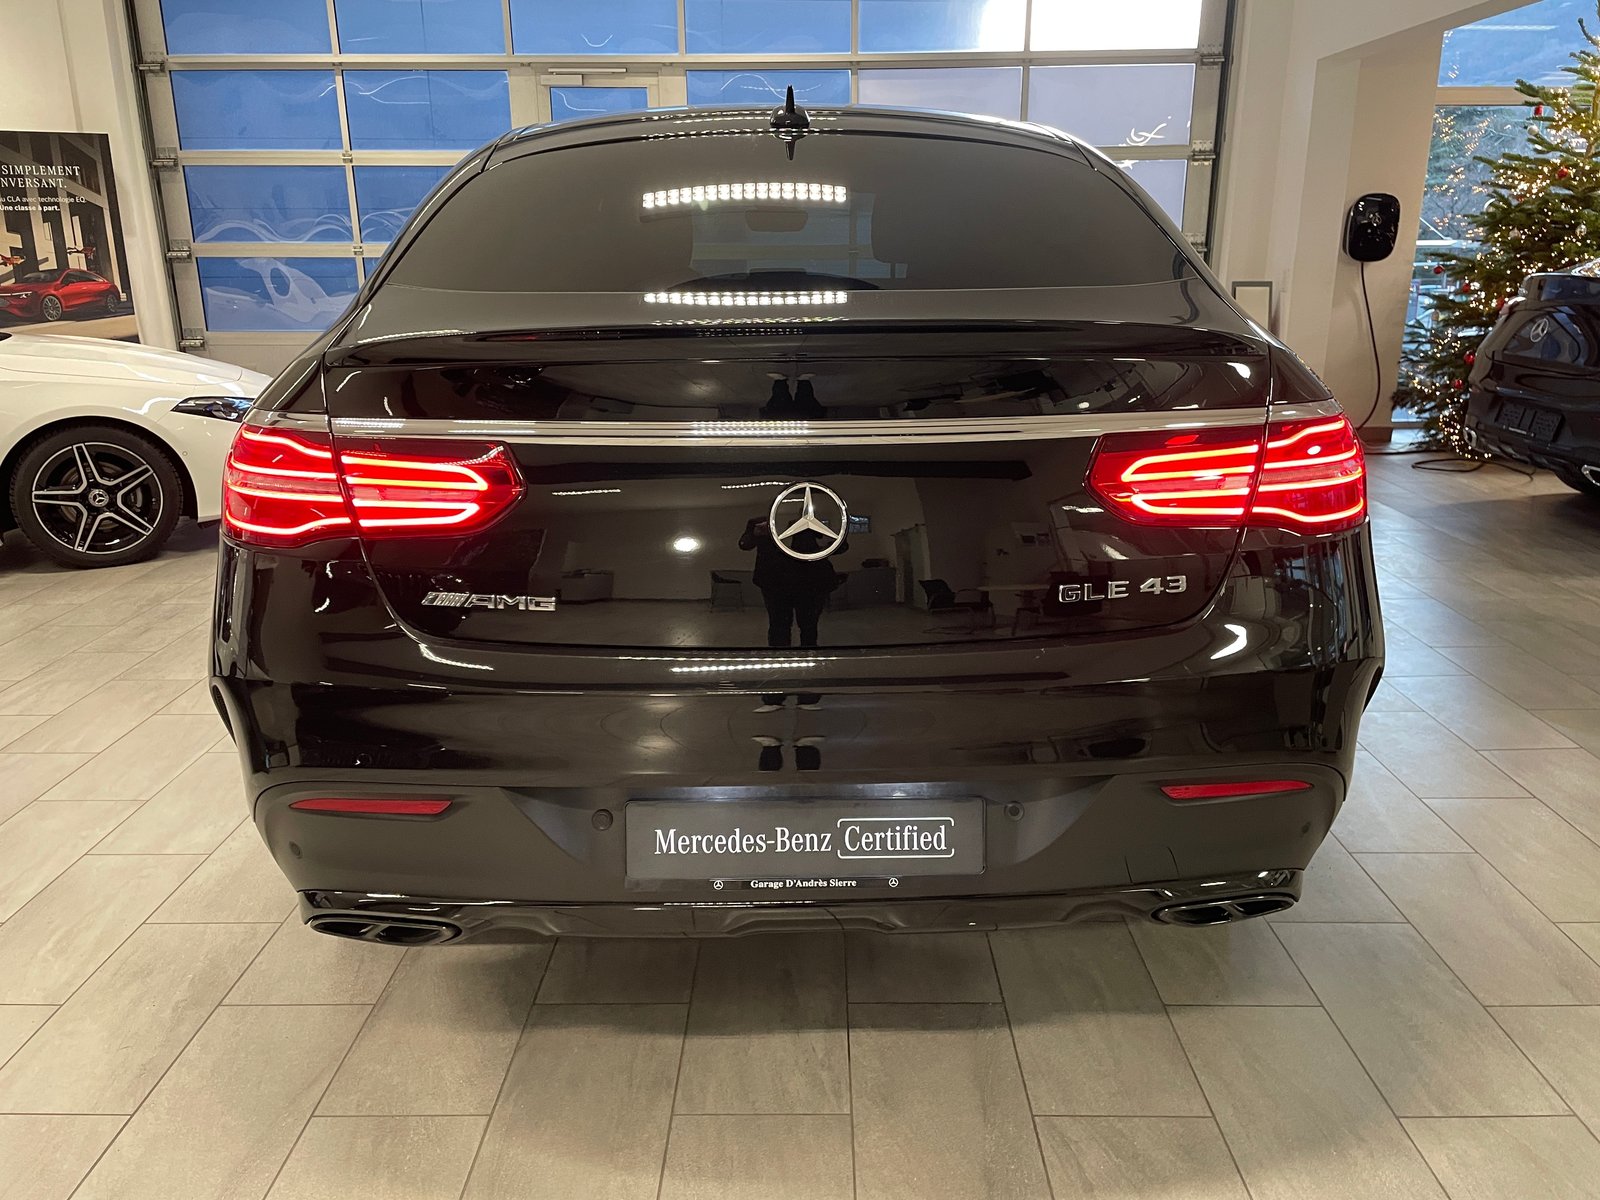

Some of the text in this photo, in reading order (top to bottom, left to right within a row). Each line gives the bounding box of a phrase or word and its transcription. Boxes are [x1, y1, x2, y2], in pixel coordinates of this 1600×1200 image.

[1, 164, 81, 176] SIMPLEMENT
[6, 195, 21, 203] CLA
[38, 196, 75, 204] technologie
[1058, 575, 1187, 603] GLE 43
[464, 593, 556, 611] AMG
[654, 824, 948, 855] Mercedes-Benz Certified
[750, 878, 857, 889] Garage D'Andrès Sierre
